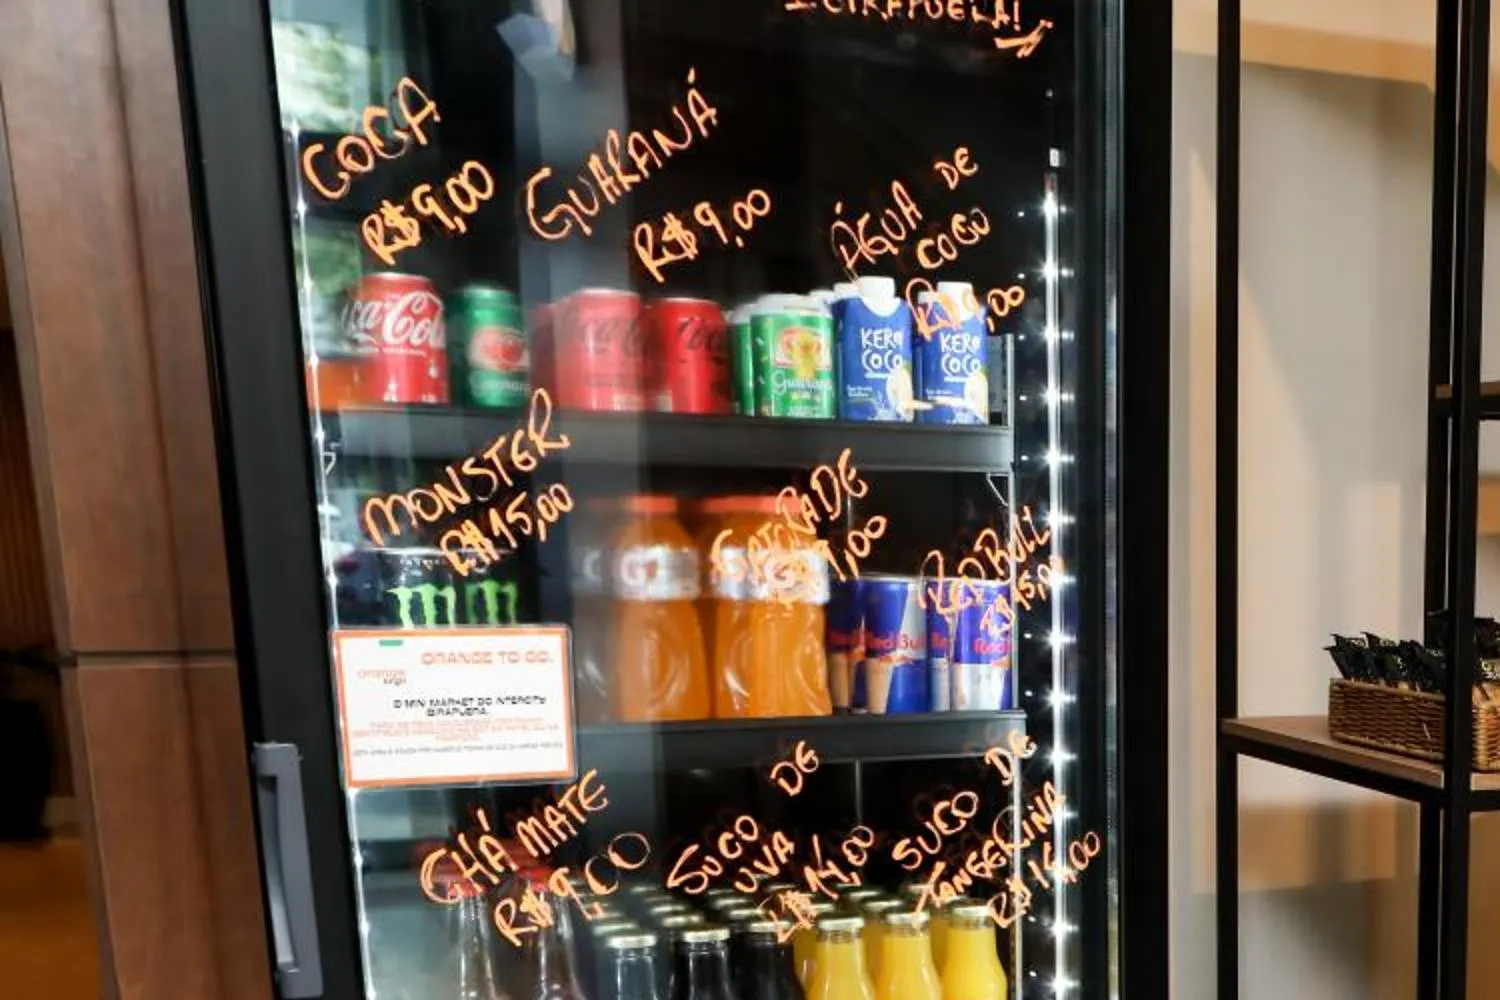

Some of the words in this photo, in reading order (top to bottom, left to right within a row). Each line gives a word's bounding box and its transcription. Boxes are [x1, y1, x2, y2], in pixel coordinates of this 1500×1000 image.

[302, 76, 440, 200] COCA
[526, 67, 719, 241] GUARANÁ
[934, 147, 978, 190] DE
[917, 208, 990, 269] COCO
[365, 388, 571, 546] MONSTER
[516, 768, 608, 857] MATE
[892, 791, 979, 870] SUCO
[667, 815, 758, 893] SUCO
[734, 831, 795, 893] UVA
